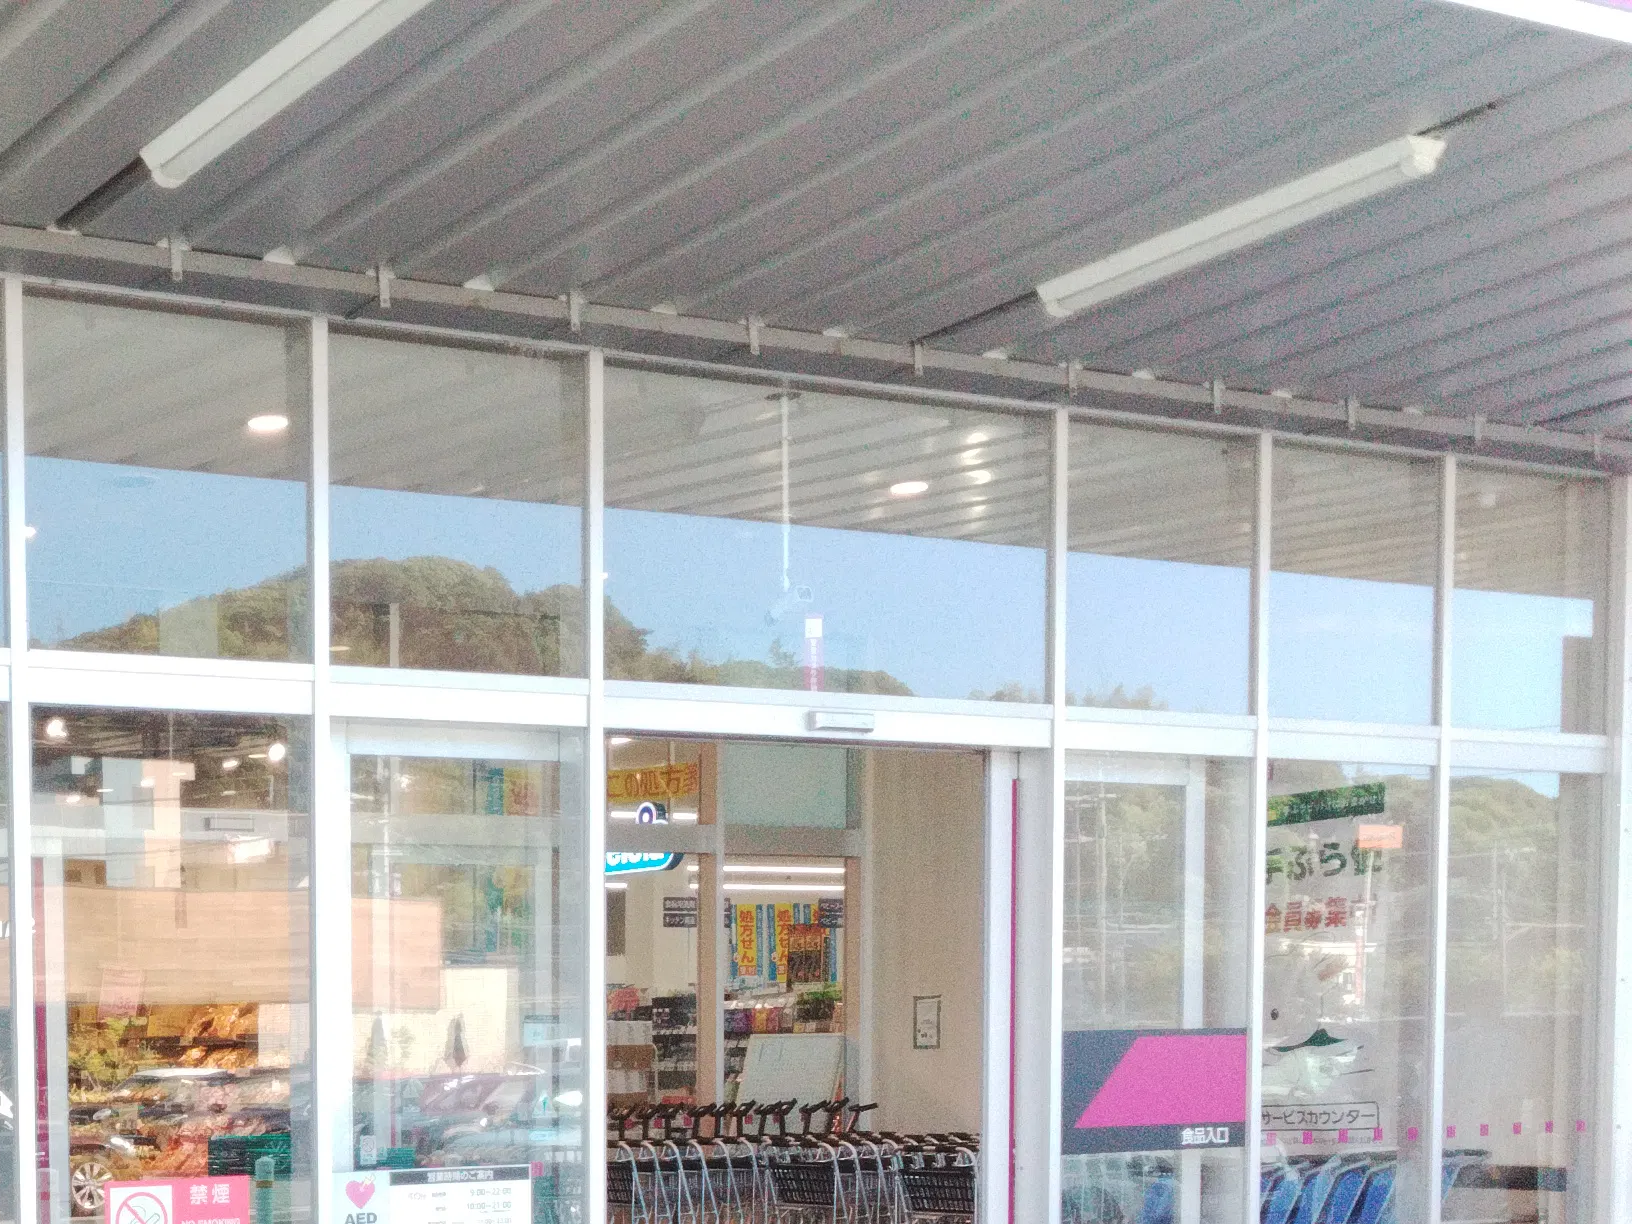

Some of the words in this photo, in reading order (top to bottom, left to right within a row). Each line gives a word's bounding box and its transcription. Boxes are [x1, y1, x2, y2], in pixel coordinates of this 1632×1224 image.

[1262, 1109, 1376, 1126] サービスカウンター
[1181, 1127, 1230, 1146] 食品入口
[189, 1184, 230, 1205] 禁煙
[345, 1212, 378, 1224] AED
